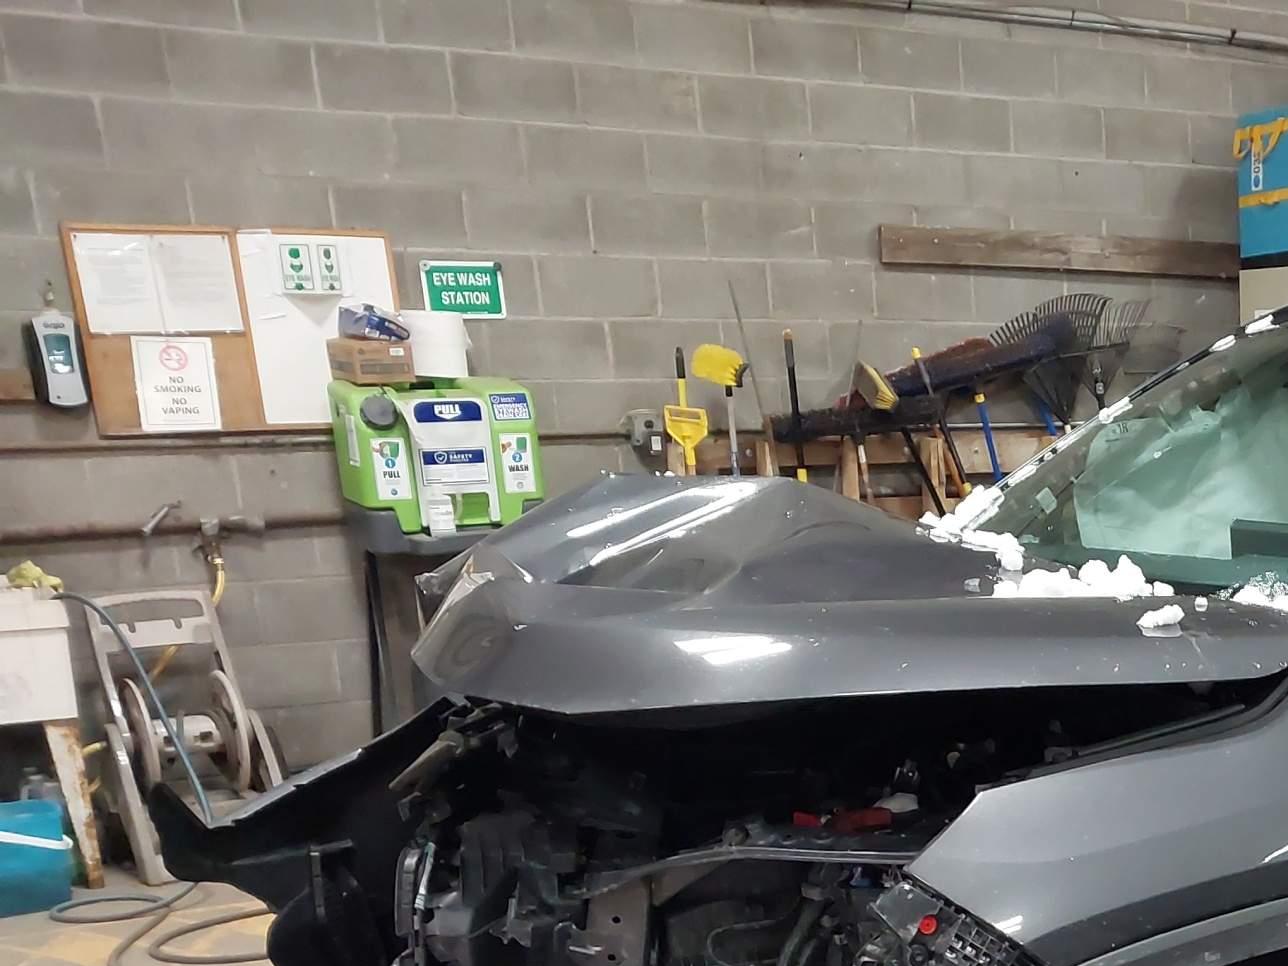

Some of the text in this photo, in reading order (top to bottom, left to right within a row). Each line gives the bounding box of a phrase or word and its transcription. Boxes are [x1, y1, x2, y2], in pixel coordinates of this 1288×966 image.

[432, 272, 491, 286] EYE WASH
[441, 291, 490, 305] STATION
[169, 376, 184, 384] NO
[153, 385, 202, 393] SMOKING
[172, 397, 187, 405] NO
[162, 407, 200, 415] VAPING
[434, 403, 462, 415] PULL
[383, 471, 401, 479] PULL
